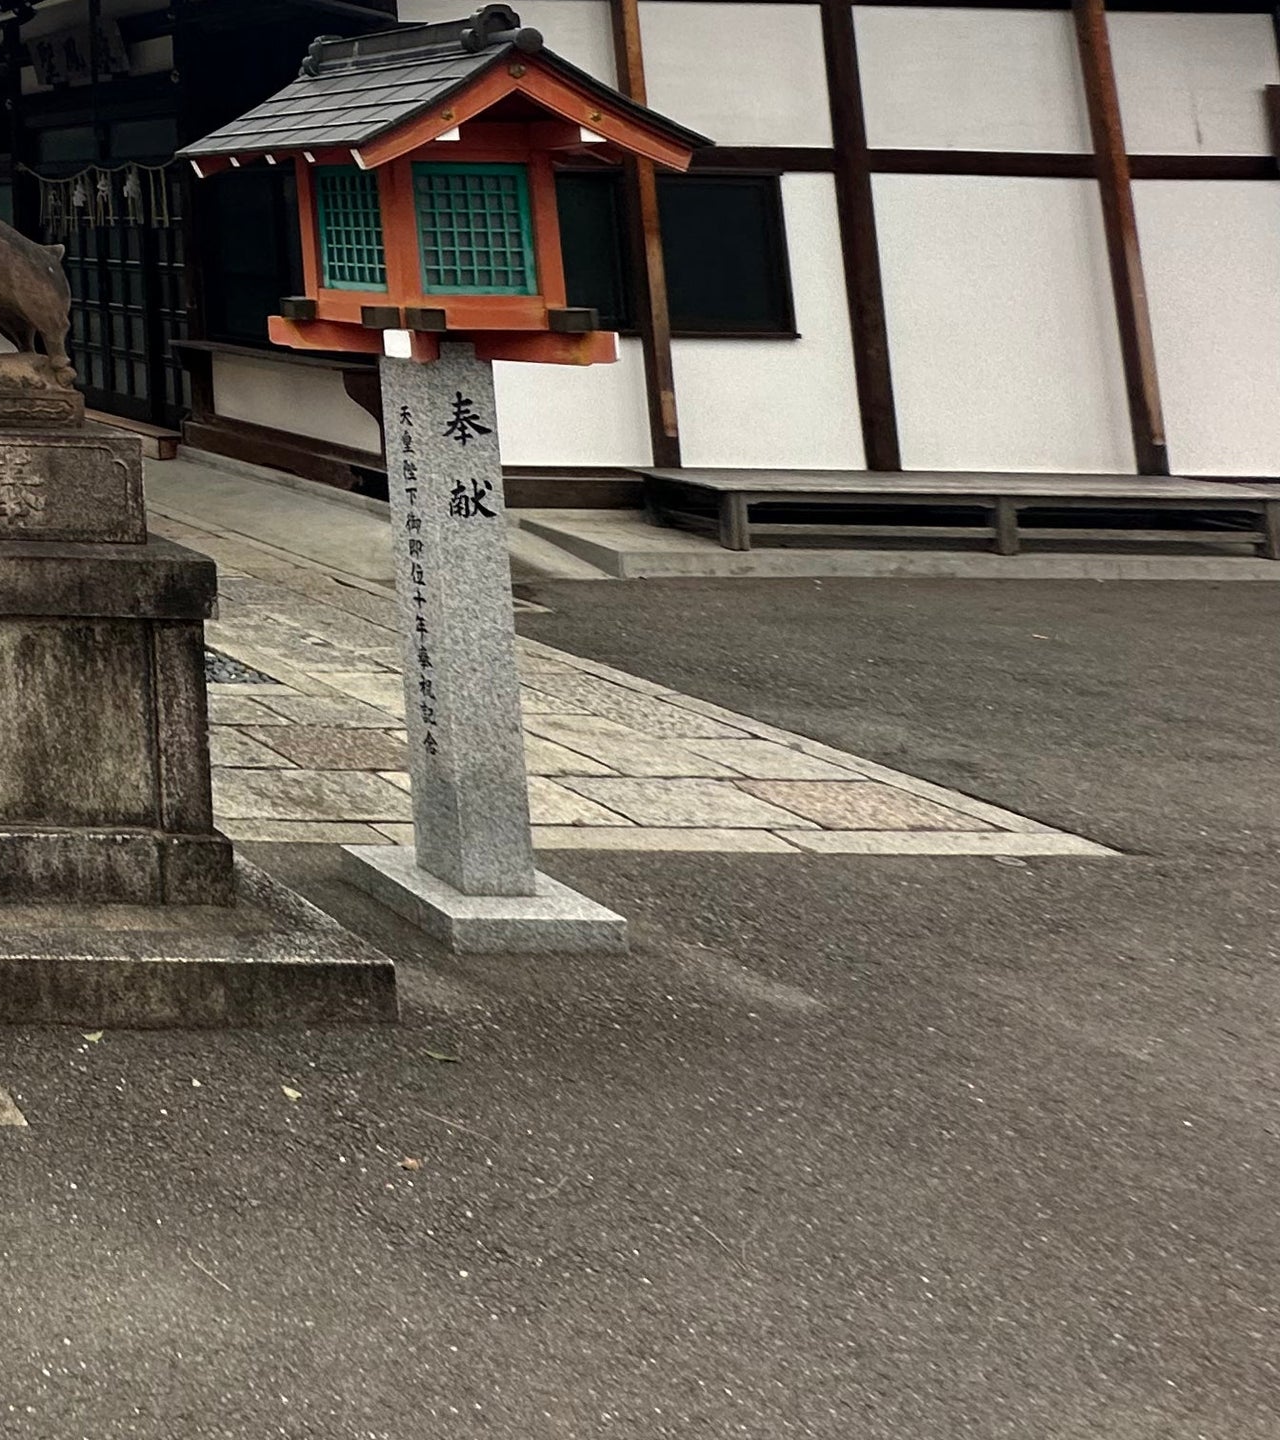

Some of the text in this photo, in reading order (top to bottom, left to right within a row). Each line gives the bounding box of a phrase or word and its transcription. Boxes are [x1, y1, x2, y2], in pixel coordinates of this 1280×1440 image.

[442, 391, 497, 519] 奉献
[399, 405, 439, 756] 天皇陛下御即位十年奉祝記念
